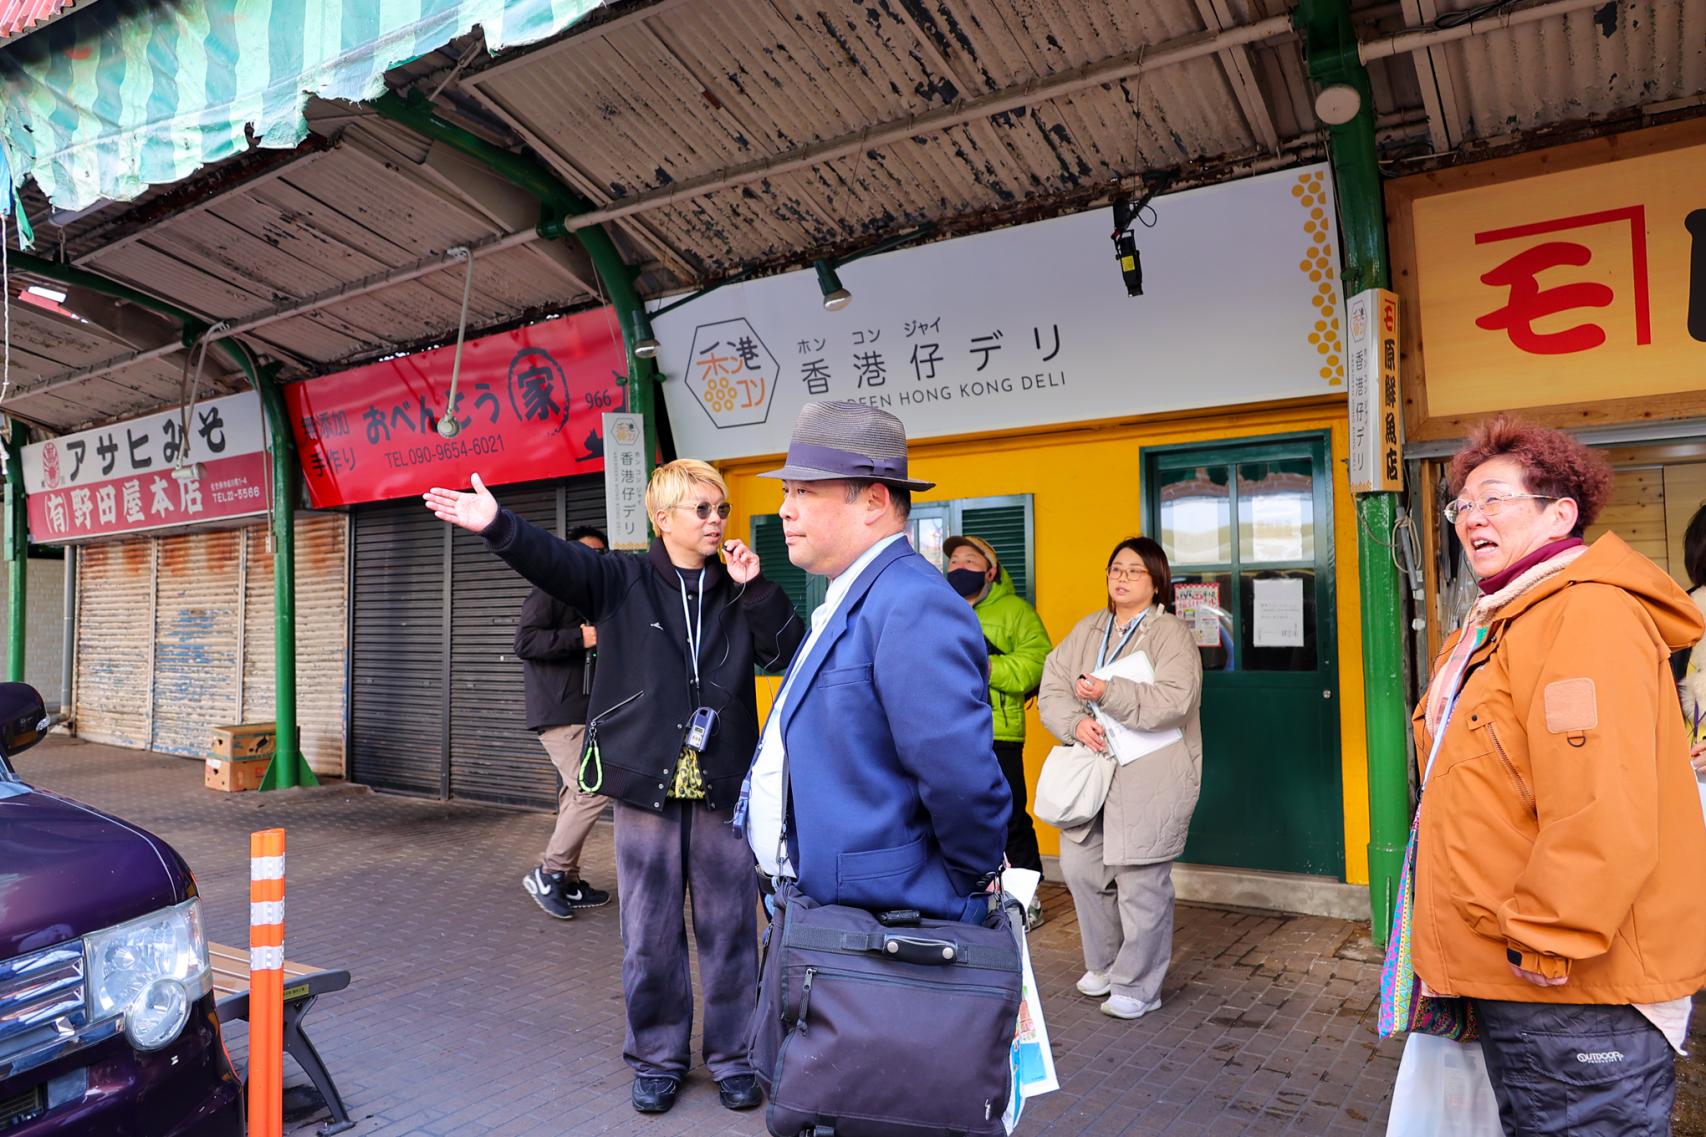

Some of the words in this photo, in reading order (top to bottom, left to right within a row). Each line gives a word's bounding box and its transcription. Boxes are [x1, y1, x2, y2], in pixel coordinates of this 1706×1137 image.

[797, 338, 825, 354] ホン
[852, 329, 880, 345] コン
[904, 316, 941, 338] ジャイ
[801, 324, 1060, 395] 香港仔デリ
[584, 389, 612, 410] 966
[899, 386, 952, 405] HONG
[960, 378, 1012, 398] KONG
[1021, 371, 1065, 391] DELI
